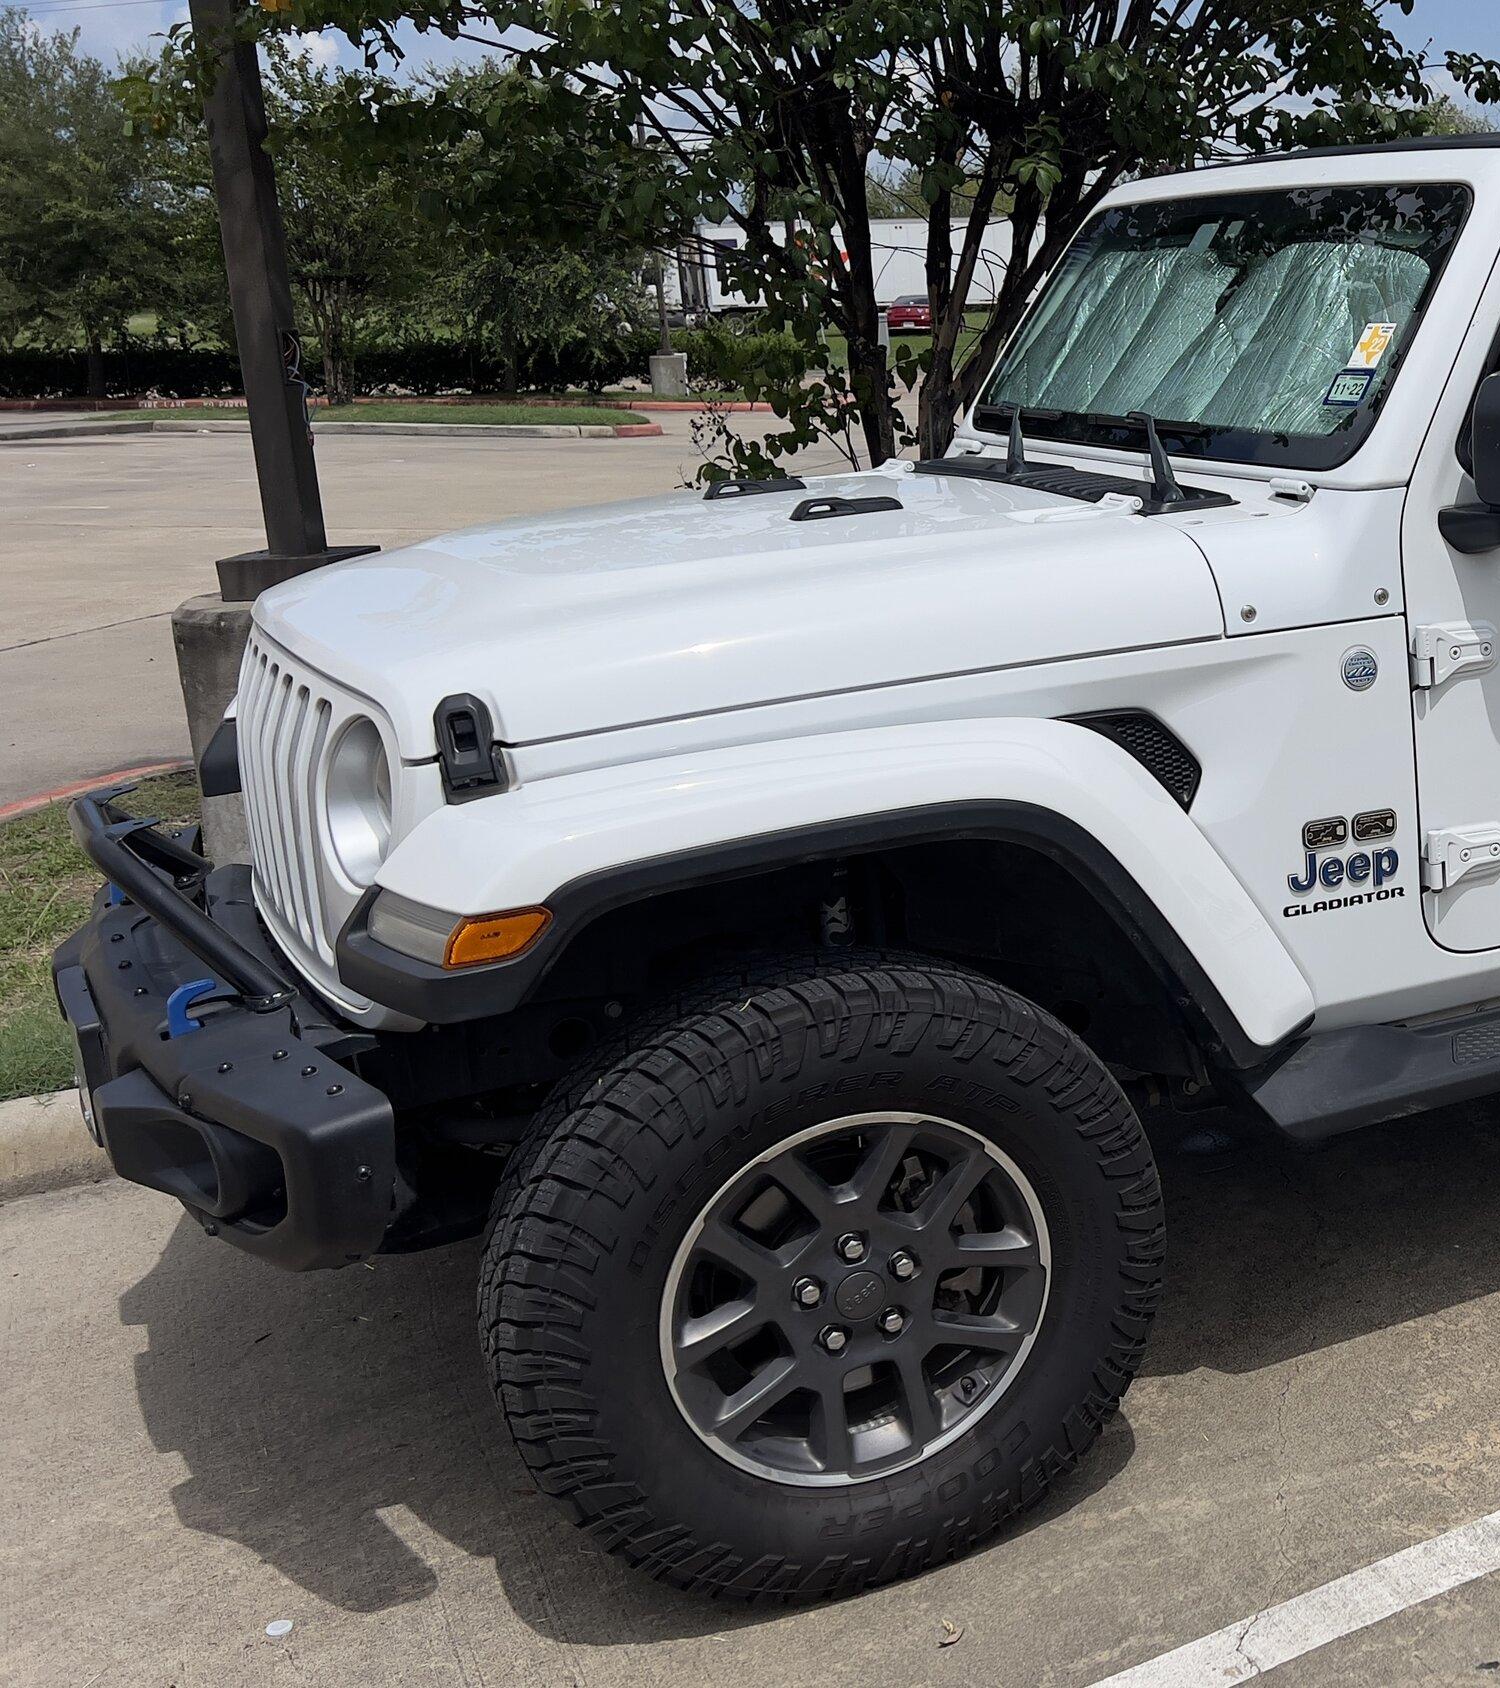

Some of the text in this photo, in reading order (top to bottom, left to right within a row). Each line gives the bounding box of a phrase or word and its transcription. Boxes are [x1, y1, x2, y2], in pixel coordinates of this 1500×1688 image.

[1367, 338, 1386, 352] 22
[219, 399, 248, 408] PARKIN
[1287, 847, 1399, 895] Jeep
[1283, 886, 1405, 918] GLADIATOR
[924, 1073, 1023, 1114] ATP
[817, 1420, 1032, 1541] COOPER
